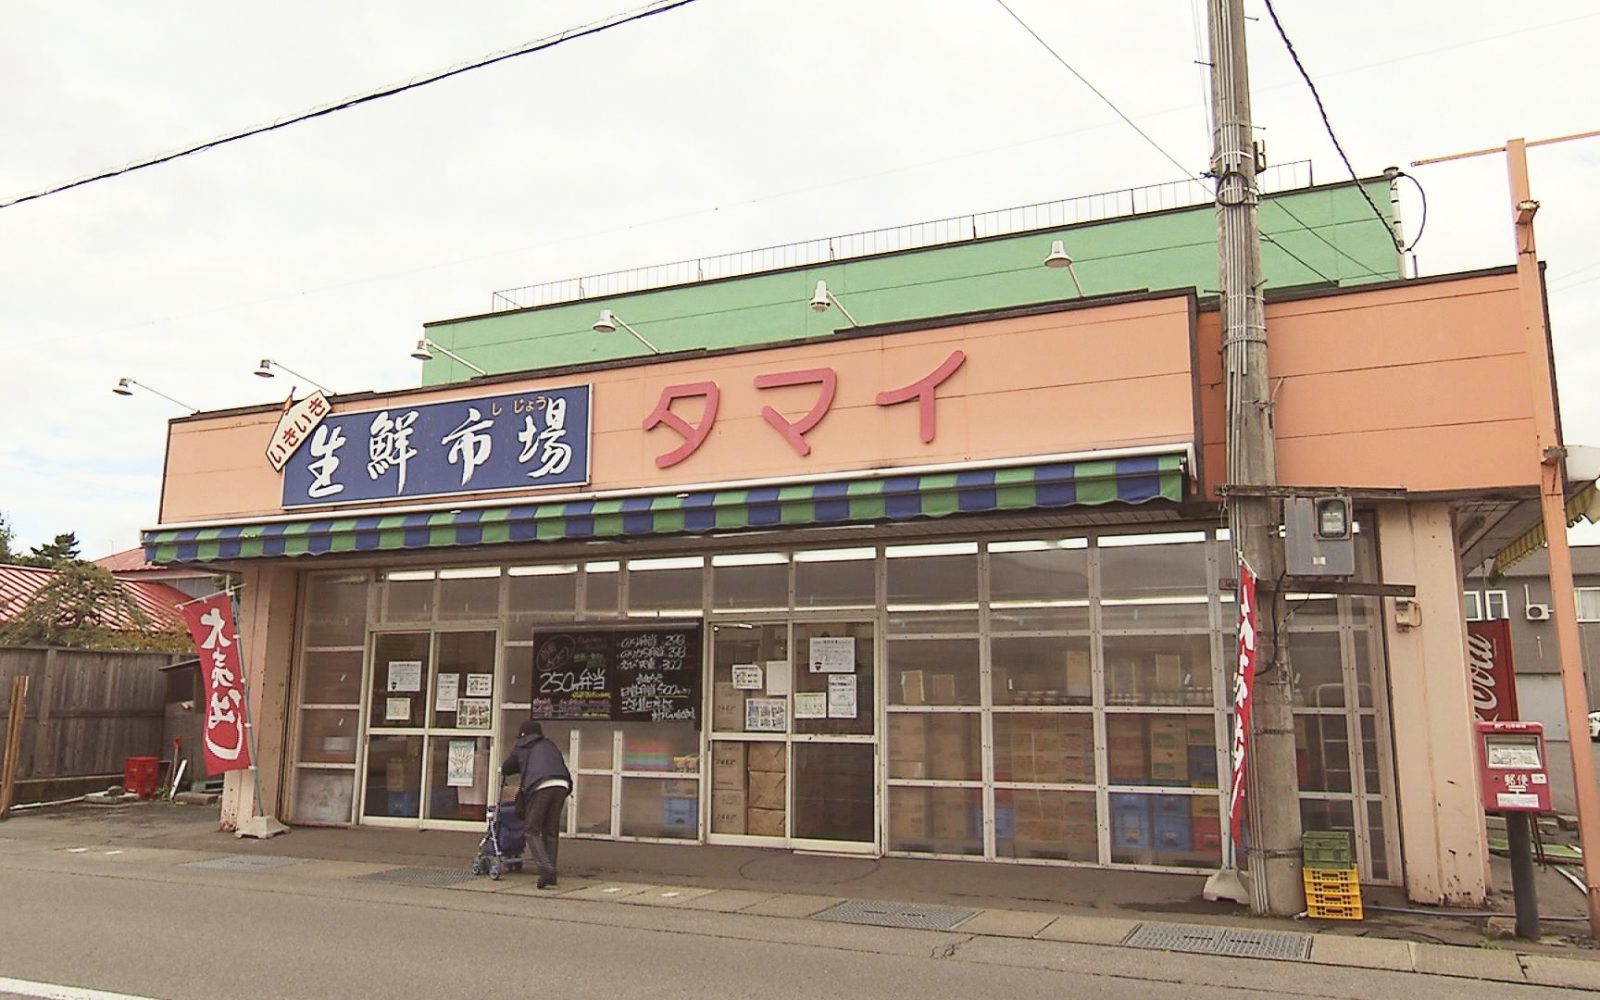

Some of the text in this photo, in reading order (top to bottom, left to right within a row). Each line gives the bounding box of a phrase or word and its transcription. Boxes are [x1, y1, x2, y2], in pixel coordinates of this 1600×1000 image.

[270, 397, 327, 463] いきいき
[307, 397, 573, 498] 生鮮市場
[643, 350, 967, 469] タマイ
